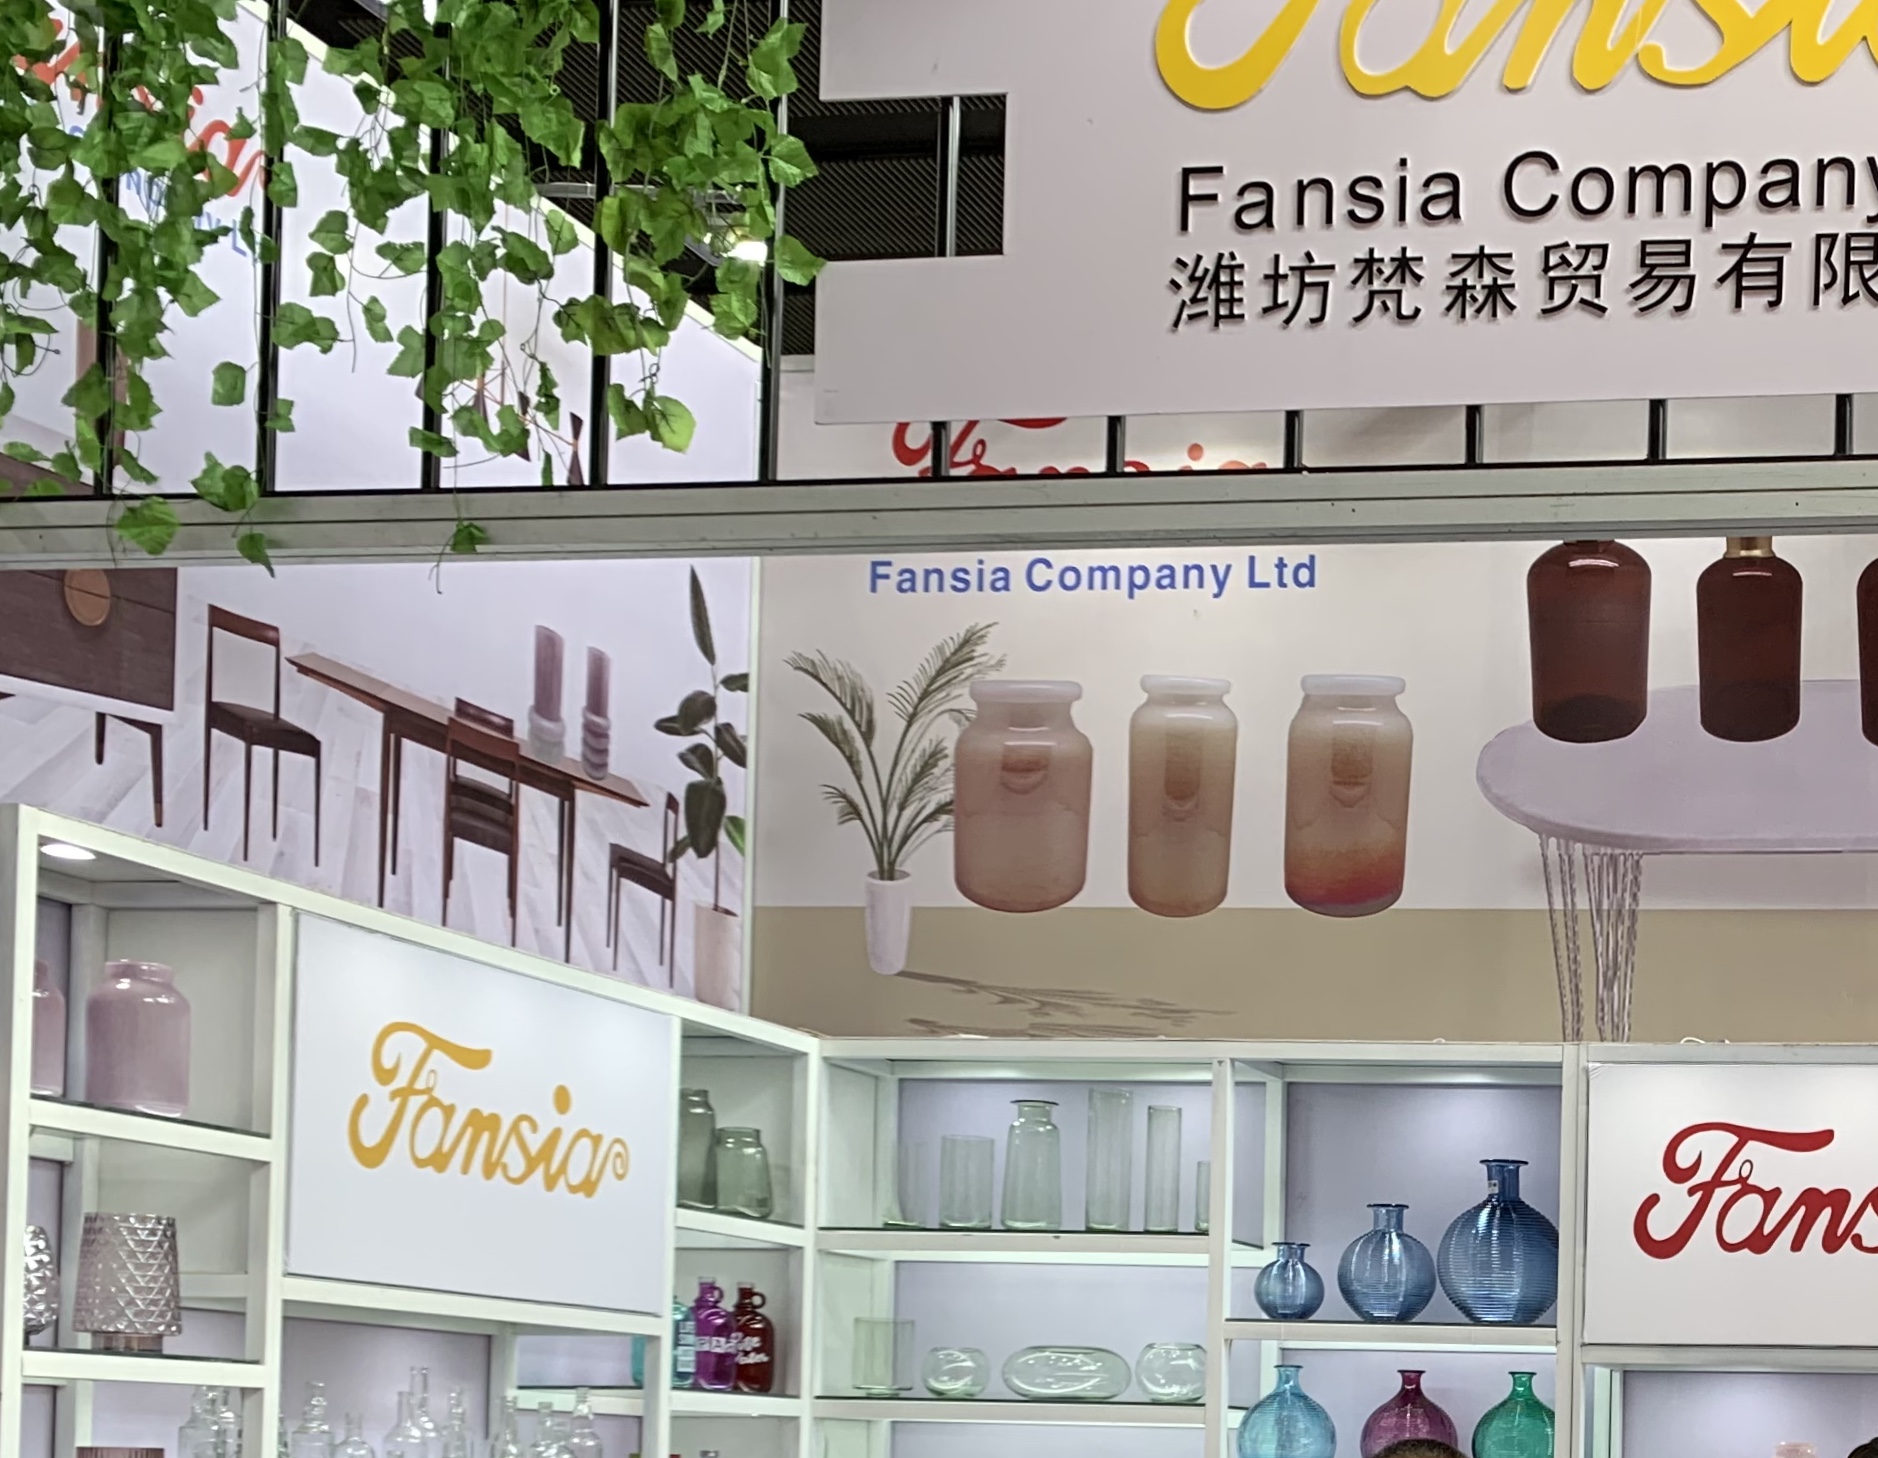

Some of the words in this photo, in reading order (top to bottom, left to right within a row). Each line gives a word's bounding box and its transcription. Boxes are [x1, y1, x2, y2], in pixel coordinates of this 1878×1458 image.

[1179, 156, 1462, 232] Fansia
[869, 559, 1011, 593] Fansia
[1024, 557, 1232, 599] Company
[1247, 555, 1316, 589] Ltd
[348, 1021, 630, 1198] Fansia
